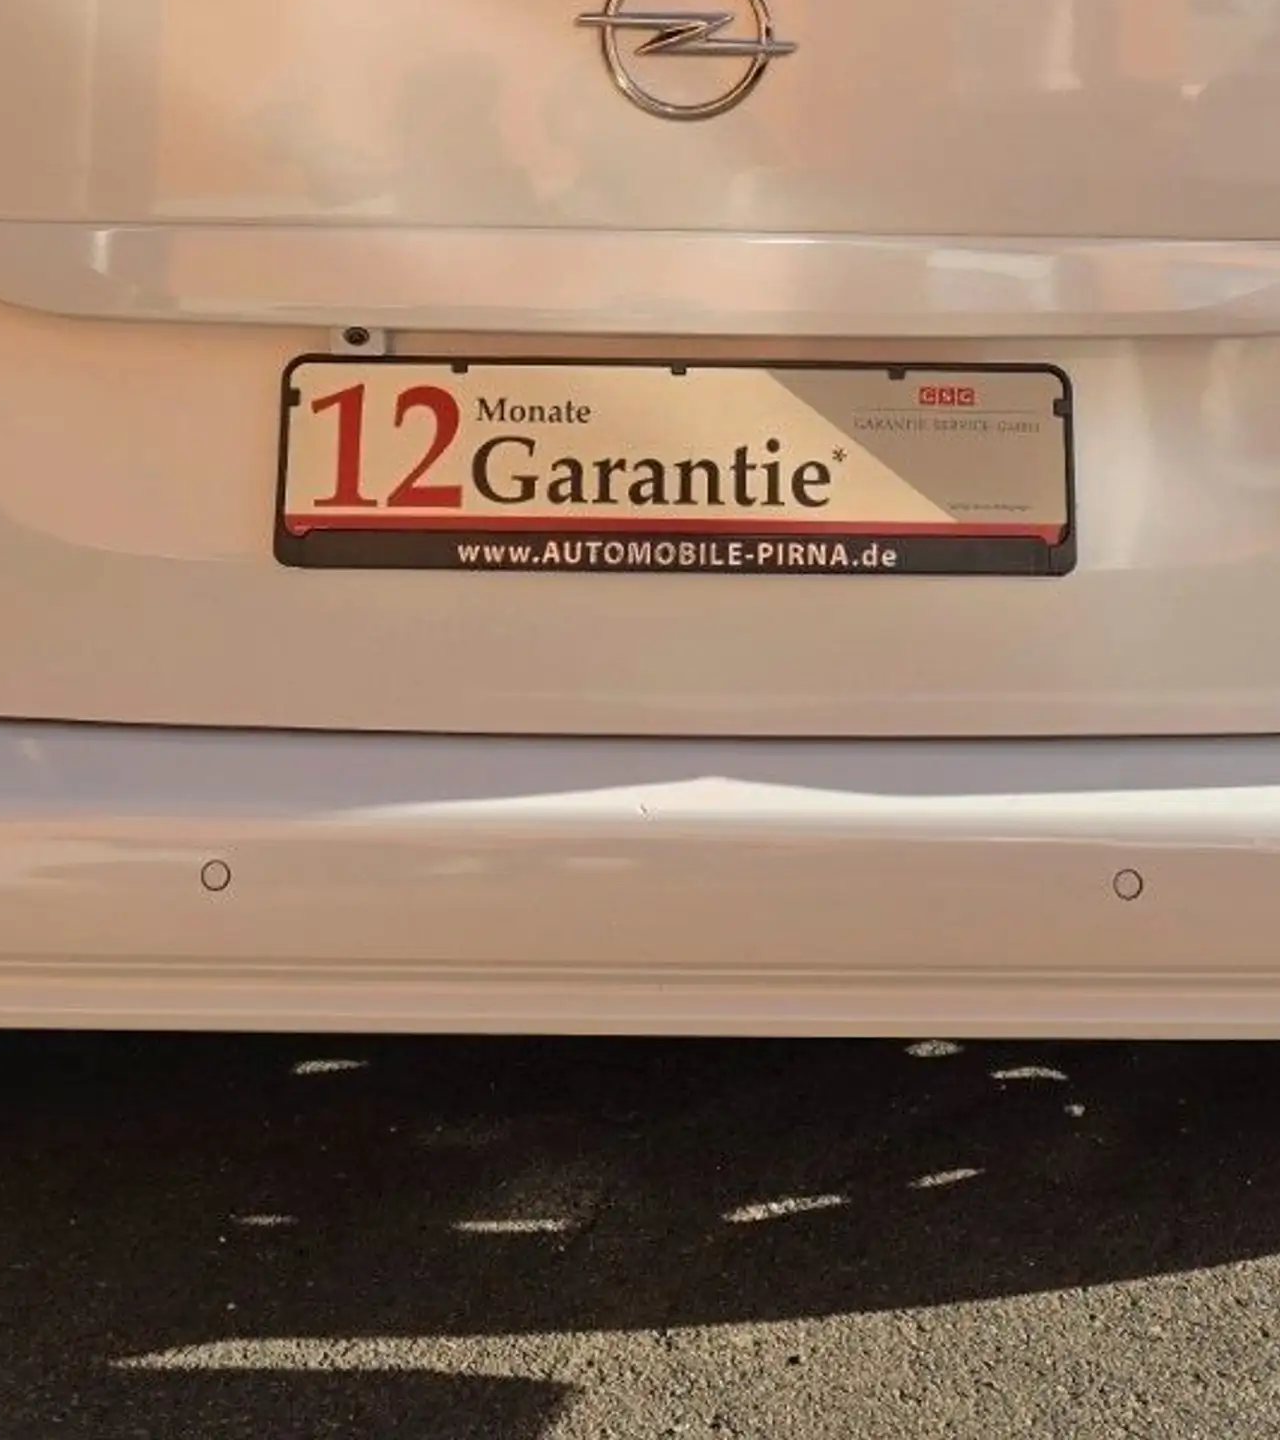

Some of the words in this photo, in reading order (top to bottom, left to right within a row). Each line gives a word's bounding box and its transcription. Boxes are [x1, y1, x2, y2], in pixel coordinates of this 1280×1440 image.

[476, 397, 592, 423] Monate
[311, 384, 462, 507] 12
[457, 540, 898, 568] www.AUTOMOBILE-PIRNA.de
